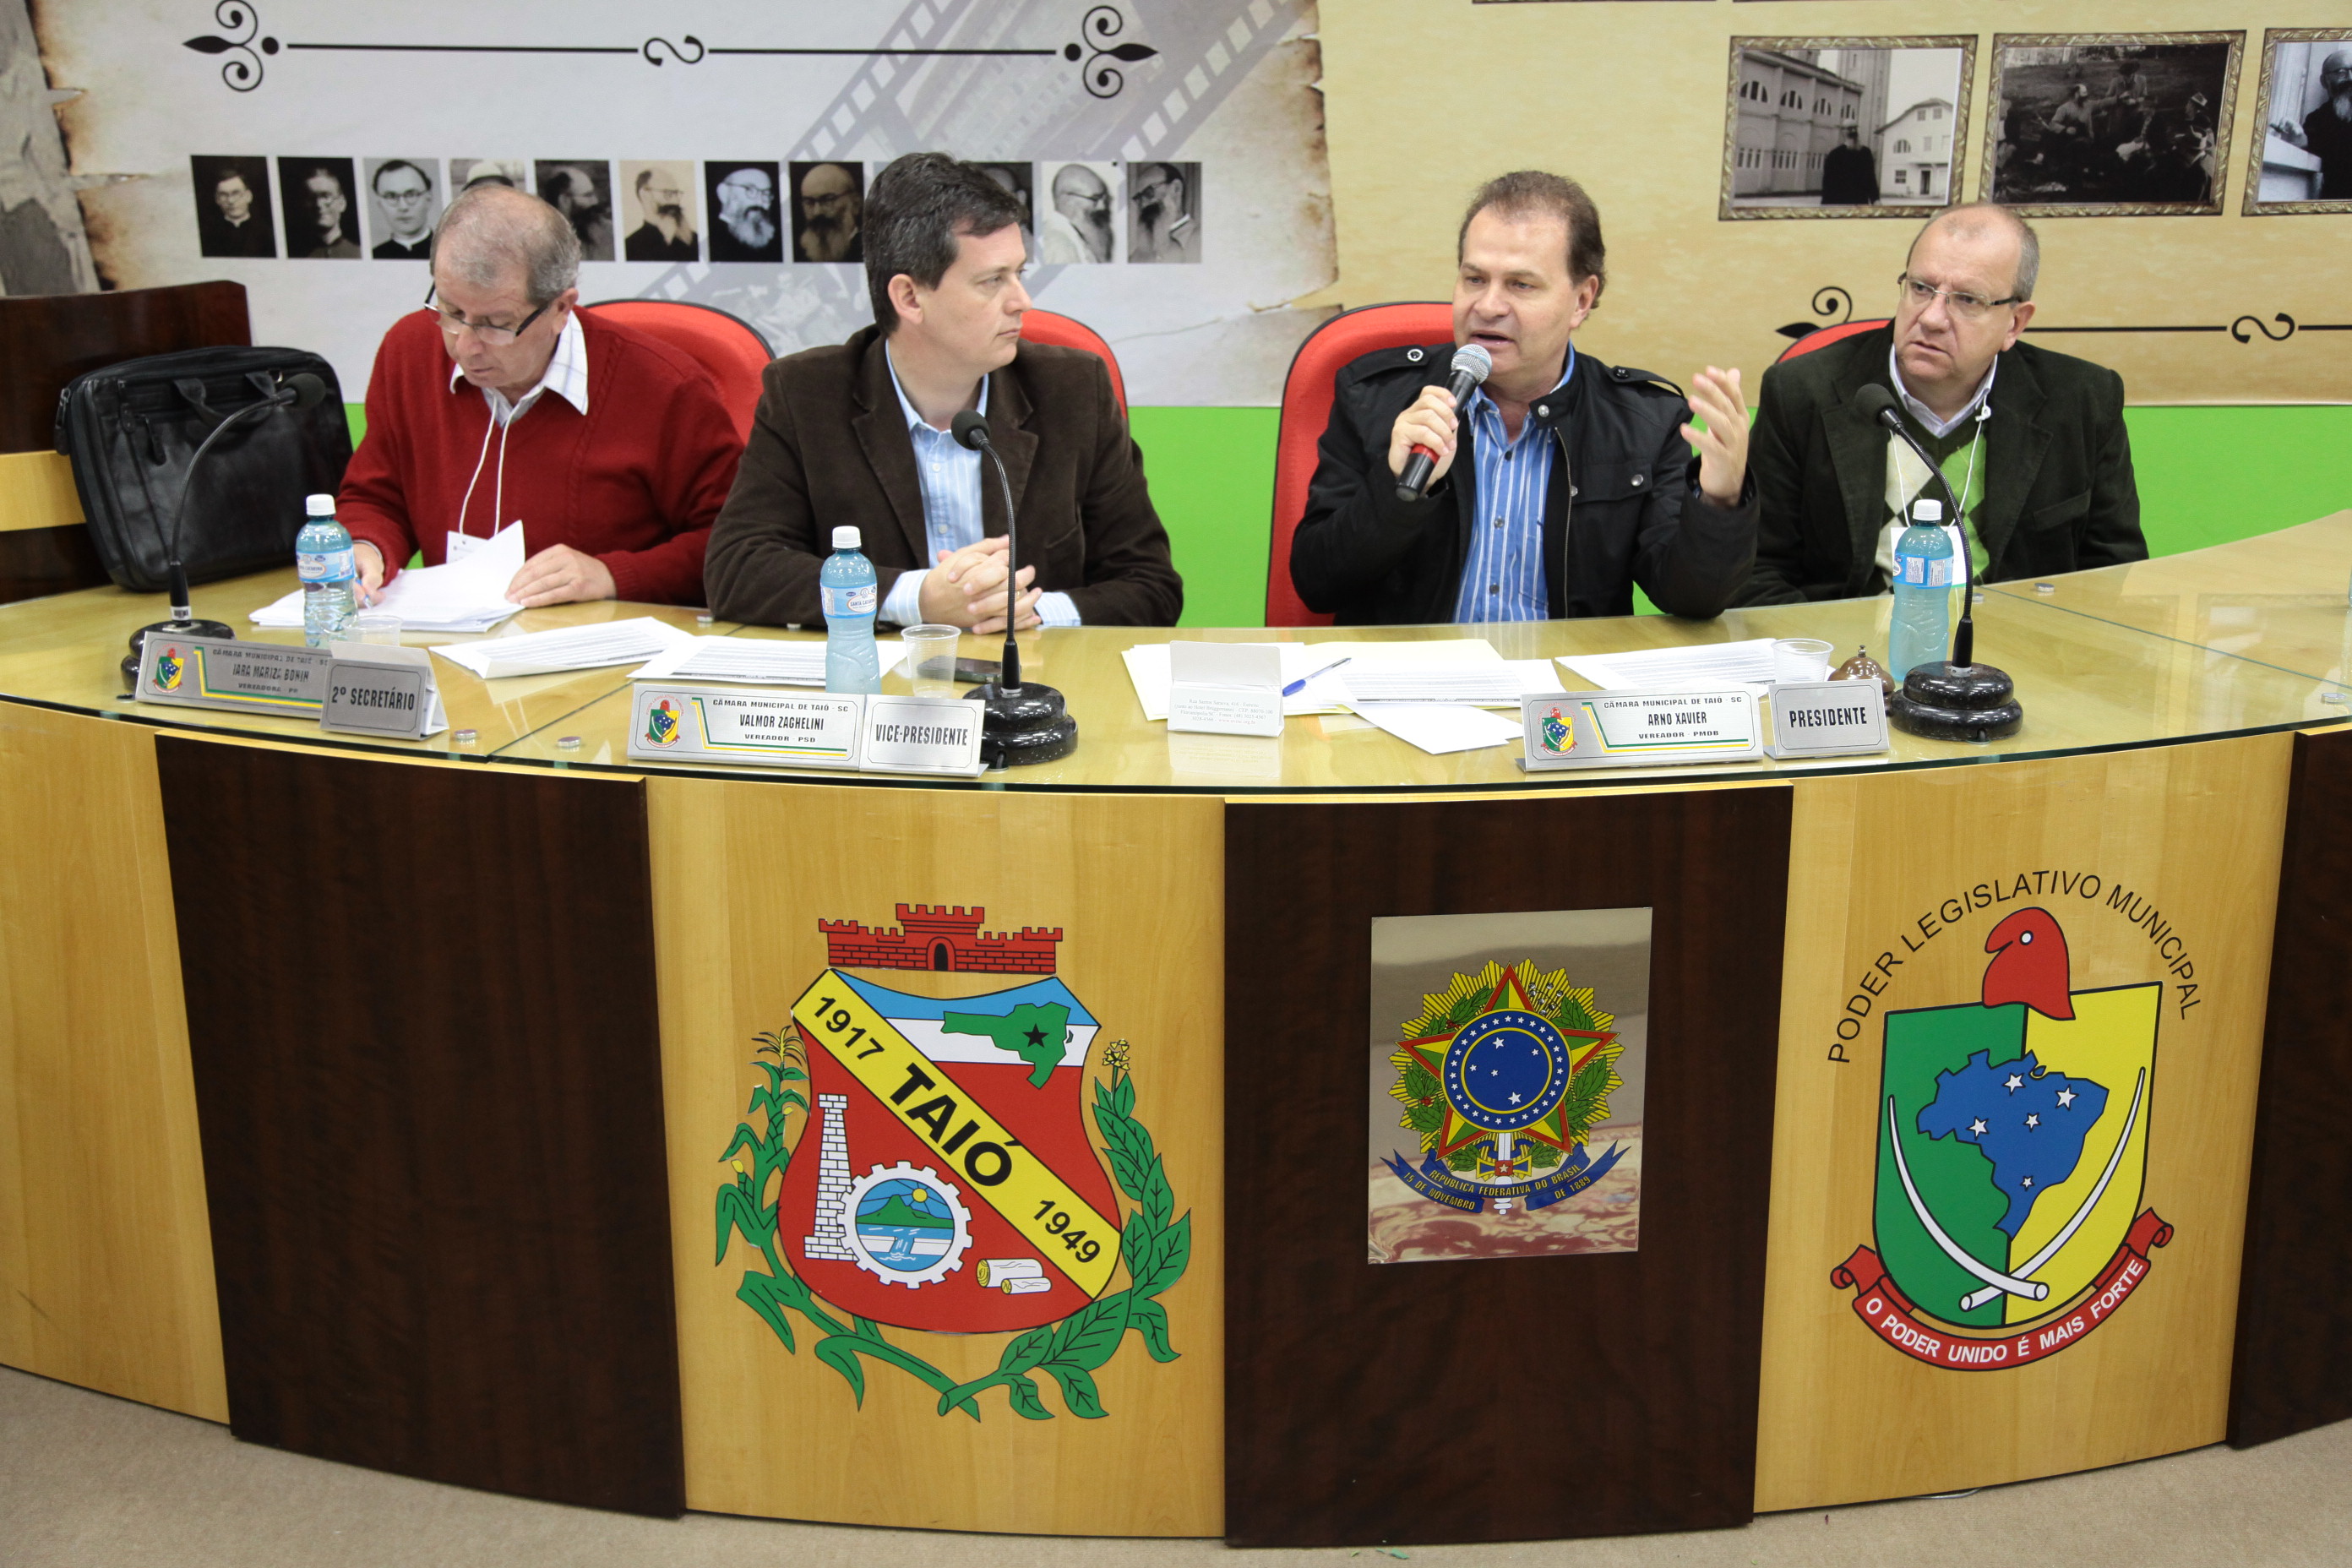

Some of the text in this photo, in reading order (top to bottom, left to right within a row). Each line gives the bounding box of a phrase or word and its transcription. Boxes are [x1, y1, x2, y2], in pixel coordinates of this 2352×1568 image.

[213, 649, 242, 657] CÂMARA
[245, 652, 283, 662] MUNICIPAL
[232, 663, 250, 676] IARA
[253, 666, 281, 680] MARIZA
[350, 686, 415, 710] SECRETÁRIO
[713, 699, 747, 707] CÂMARA
[750, 700, 794, 710] MUNICIPAL
[1603, 700, 1639, 709] CÂMARA
[1642, 698, 1688, 707] MUNICIPAL
[1704, 696, 1723, 705] TAIÓ
[739, 713, 825, 730] VALMOR ZAGHELINI
[1647, 711, 1707, 727] ARNO XAVIER
[1789, 706, 1867, 728] PRESIDENTE
[745, 733, 790, 742] VEREADOR
[875, 724, 968, 746] VICE-PRESIDENTE
[1638, 732, 1685, 740] VEREADOR
[1827, 870, 2201, 1063] PODER LEGISLATIVO MUNICIPAL
[814, 996, 1101, 1264] 1917 TAIÓ 1949
[1404, 1172, 1475, 1210] 15 DE NOVEMBRO
[1429, 1164, 1582, 1196] REPUBLICA FEDERATIVA DO BRASIL
[1554, 1176, 1591, 1200] DE 1889
[1865, 1259, 2143, 1363] O PODER UNIDO É MAIS FORTE
